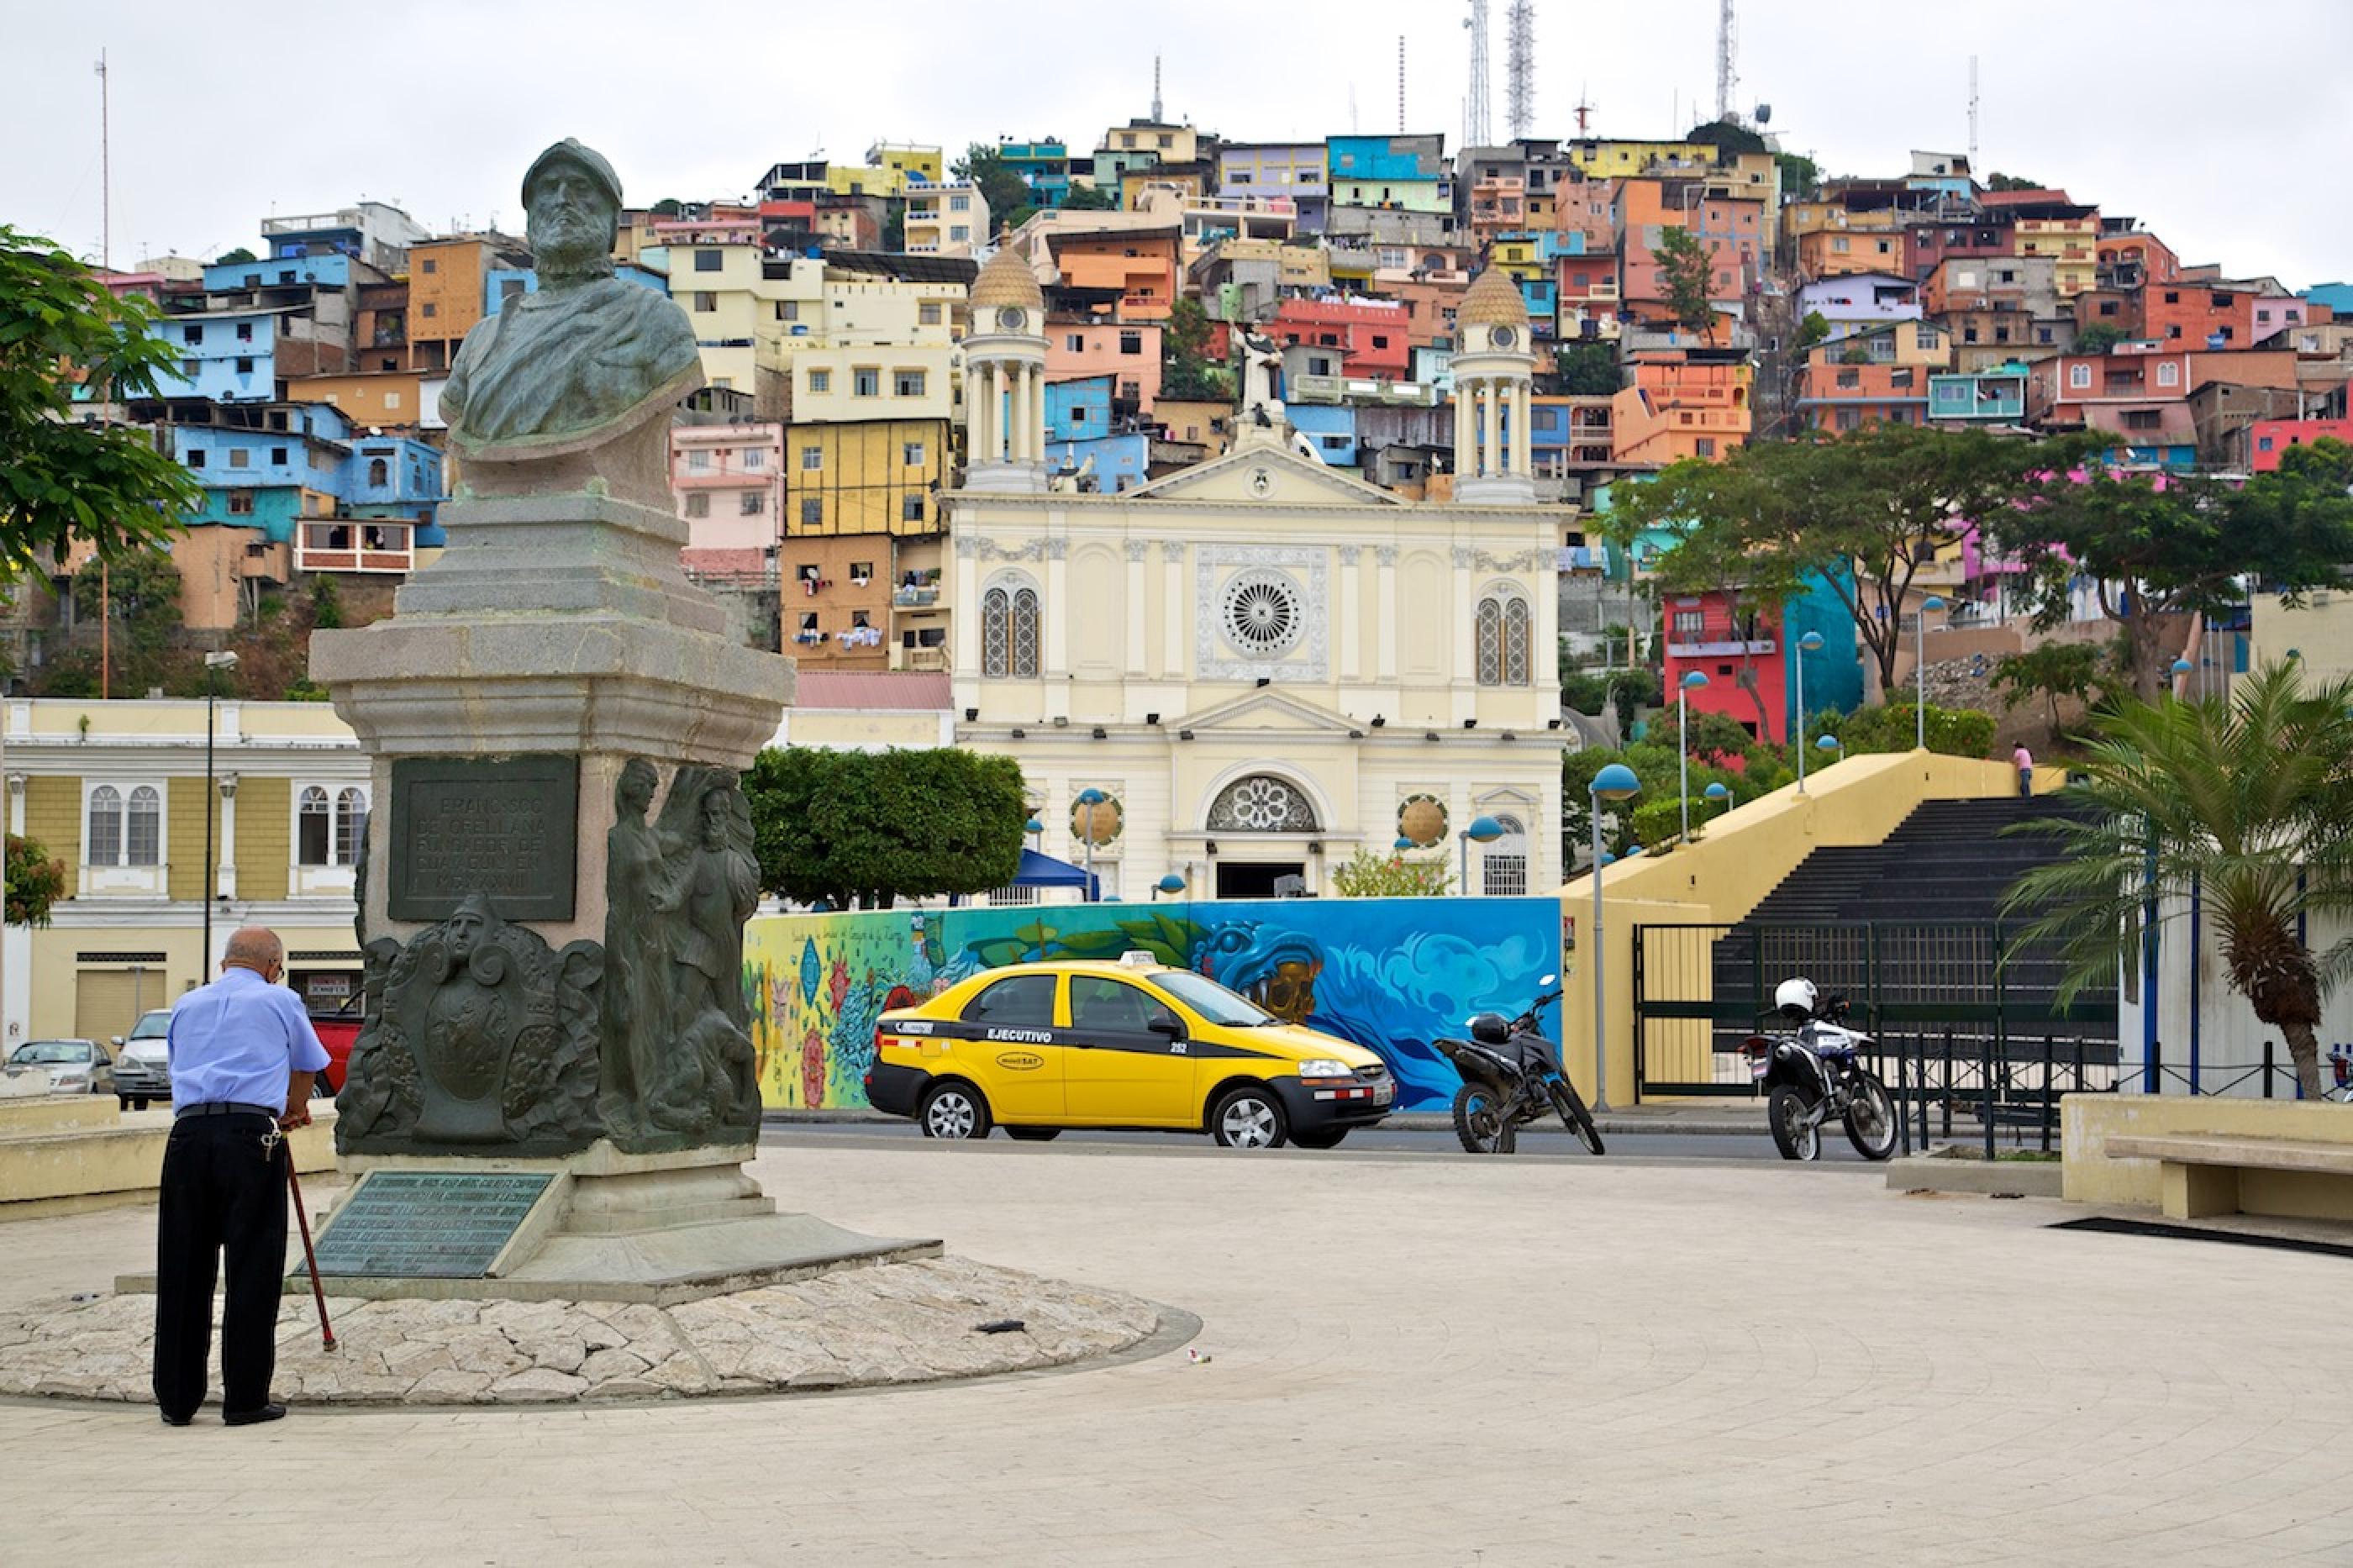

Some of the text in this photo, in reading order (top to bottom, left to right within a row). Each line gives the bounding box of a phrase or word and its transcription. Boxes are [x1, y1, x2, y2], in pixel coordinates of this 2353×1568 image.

[442, 798, 544, 814] FRANCISCO
[416, 818, 545, 834] DE ORELLANA
[518, 839, 542, 853] DE
[517, 855, 540, 871] EN
[987, 1028, 1052, 1043] EJECUTIVO
